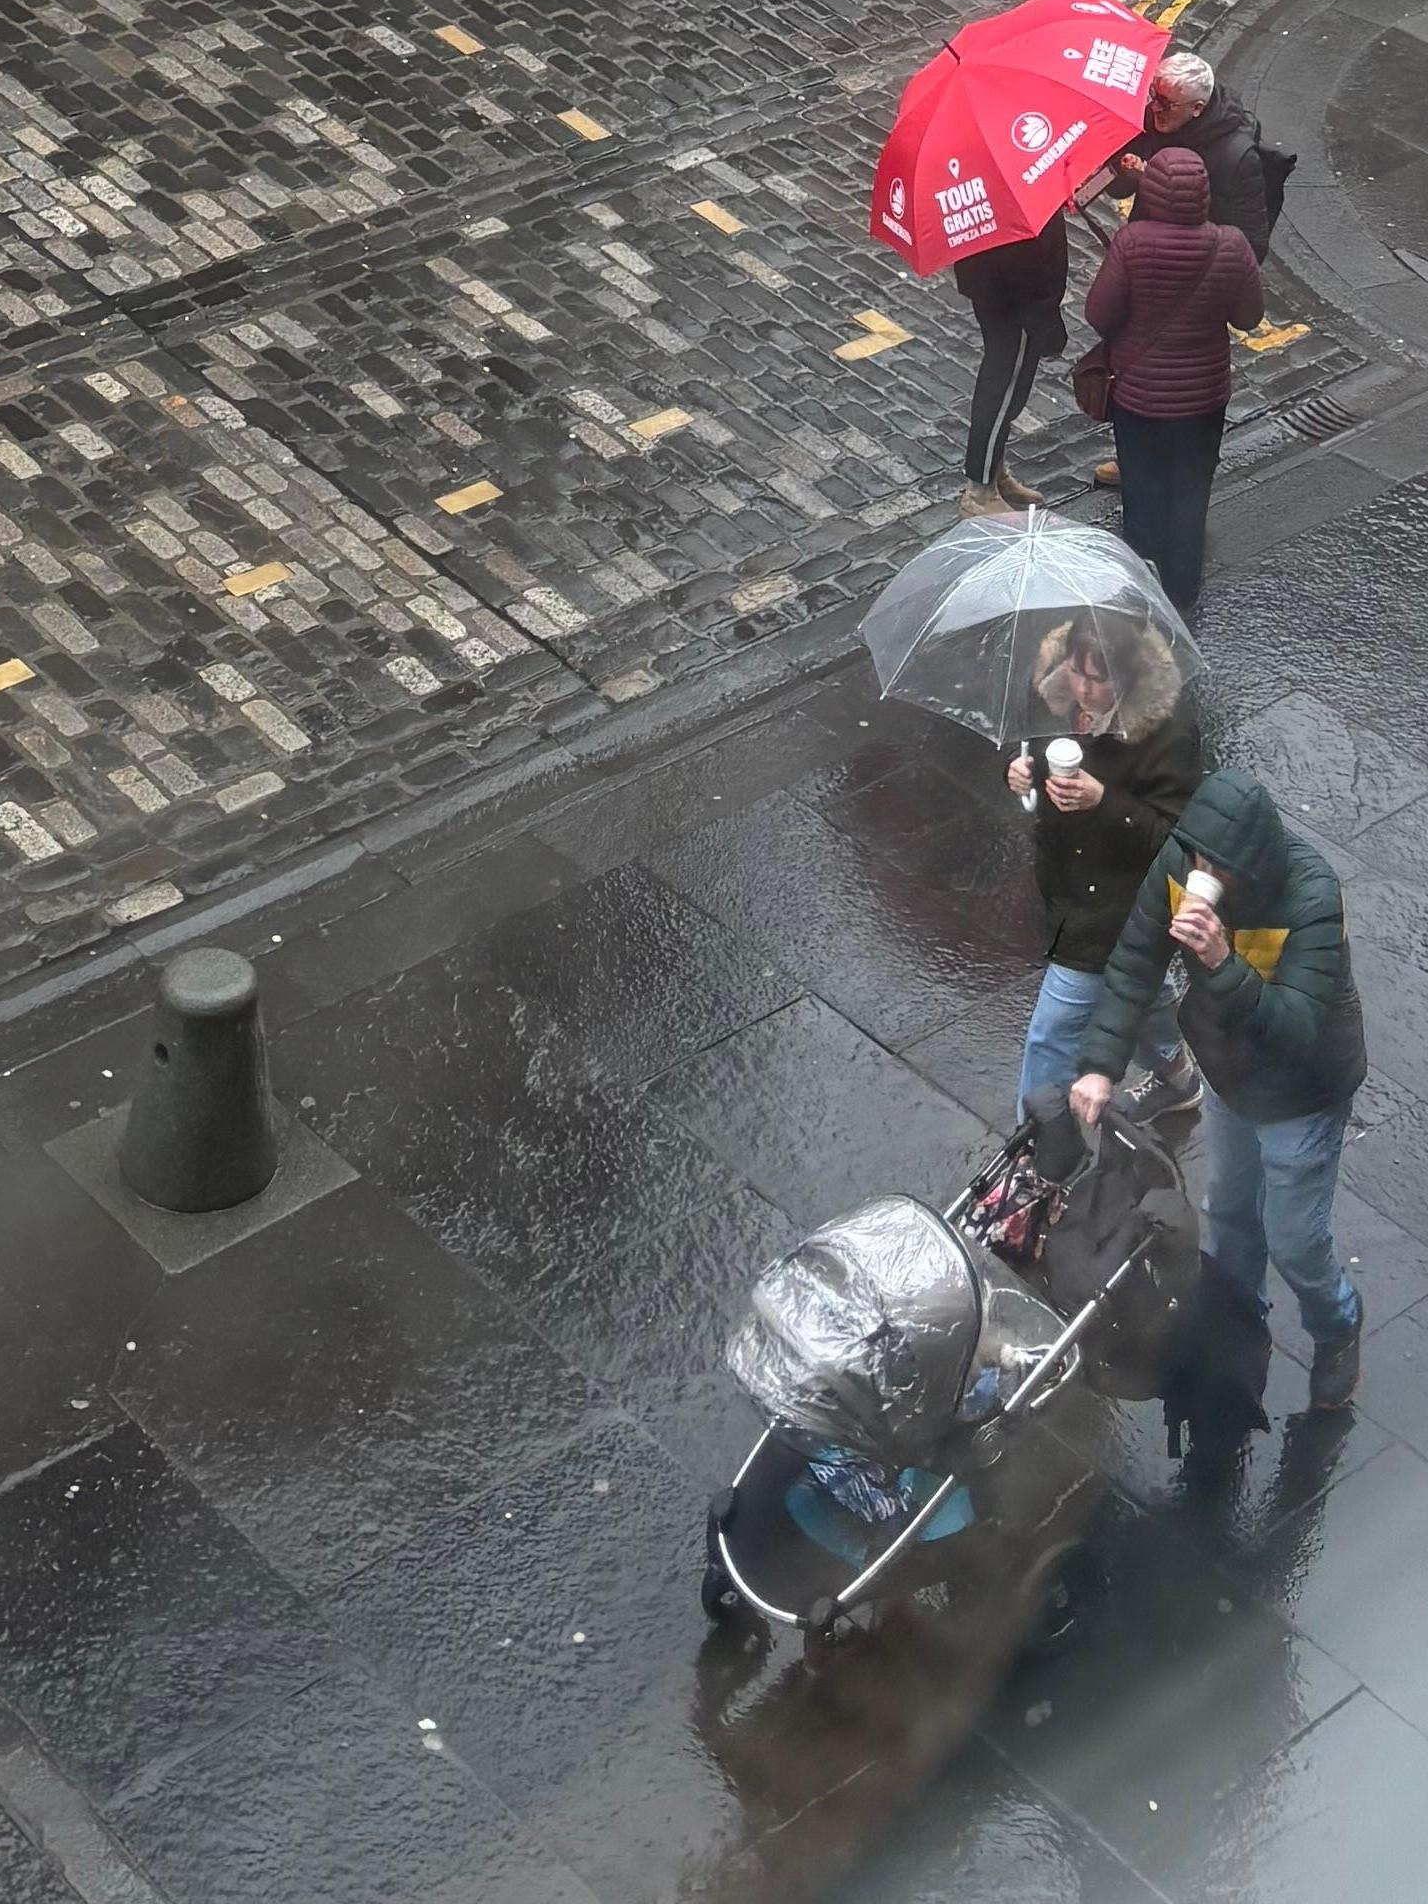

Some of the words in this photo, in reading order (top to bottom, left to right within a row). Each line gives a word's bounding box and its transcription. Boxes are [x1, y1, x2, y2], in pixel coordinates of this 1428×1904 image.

[1082, 37, 1116, 85] FREE
[1104, 45, 1139, 91] TOUR
[934, 176, 987, 215] TOUR
[943, 201, 994, 235] GRATIS
